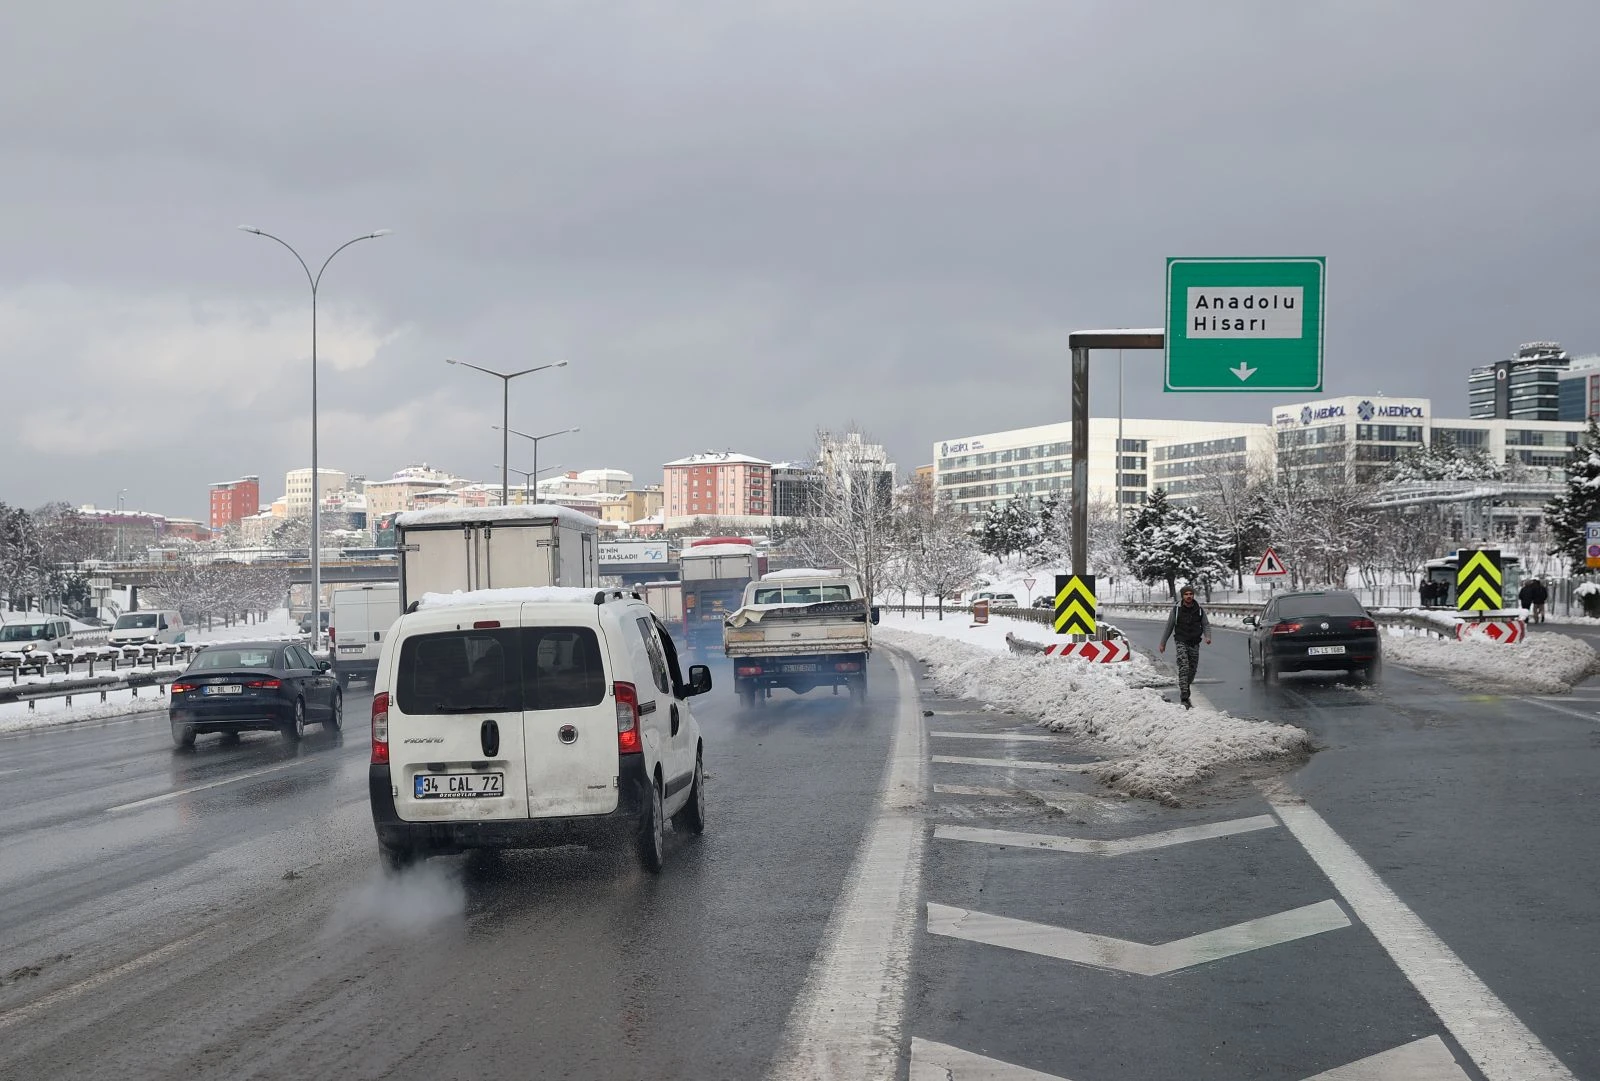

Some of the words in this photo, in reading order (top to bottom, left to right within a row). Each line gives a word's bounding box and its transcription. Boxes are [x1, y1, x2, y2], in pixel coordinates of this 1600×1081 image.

[1195, 295, 1295, 309] Anadolu
[1194, 316, 1266, 331] Hisarı
[1378, 404, 1424, 418] MEDİPOL
[230, 685, 241, 693] 177
[423, 778, 439, 792] 34
[449, 777, 473, 791] CAL
[482, 776, 499, 791] 72
